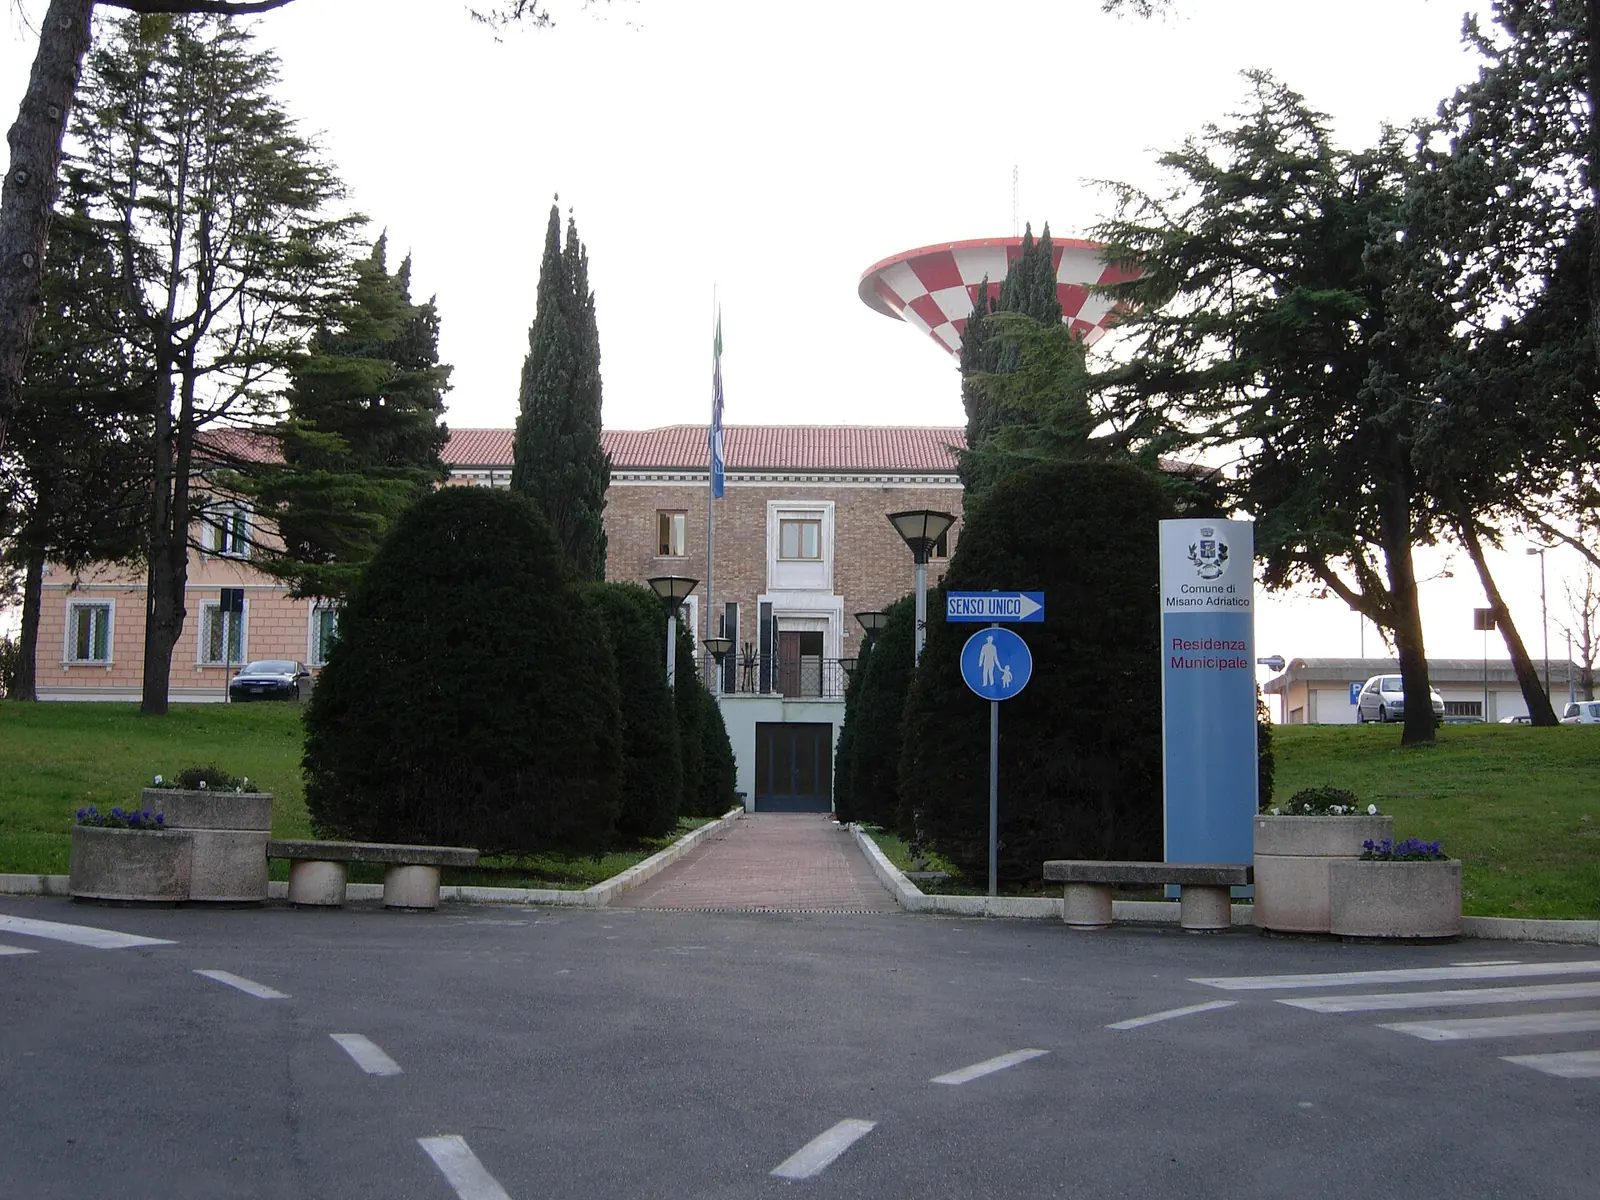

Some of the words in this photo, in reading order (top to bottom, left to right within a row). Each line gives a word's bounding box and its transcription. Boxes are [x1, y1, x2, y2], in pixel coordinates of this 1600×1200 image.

[1181, 584, 1223, 593] Comune
[1226, 584, 1236, 593] di
[949, 599, 984, 614] SENSO
[988, 599, 1021, 614] UNICO
[1166, 597, 1203, 606] Misano
[1206, 596, 1249, 606] Adriatico
[1172, 638, 1246, 650] Residenza
[1171, 656, 1247, 671] Municipale
[1352, 684, 1361, 695] P
